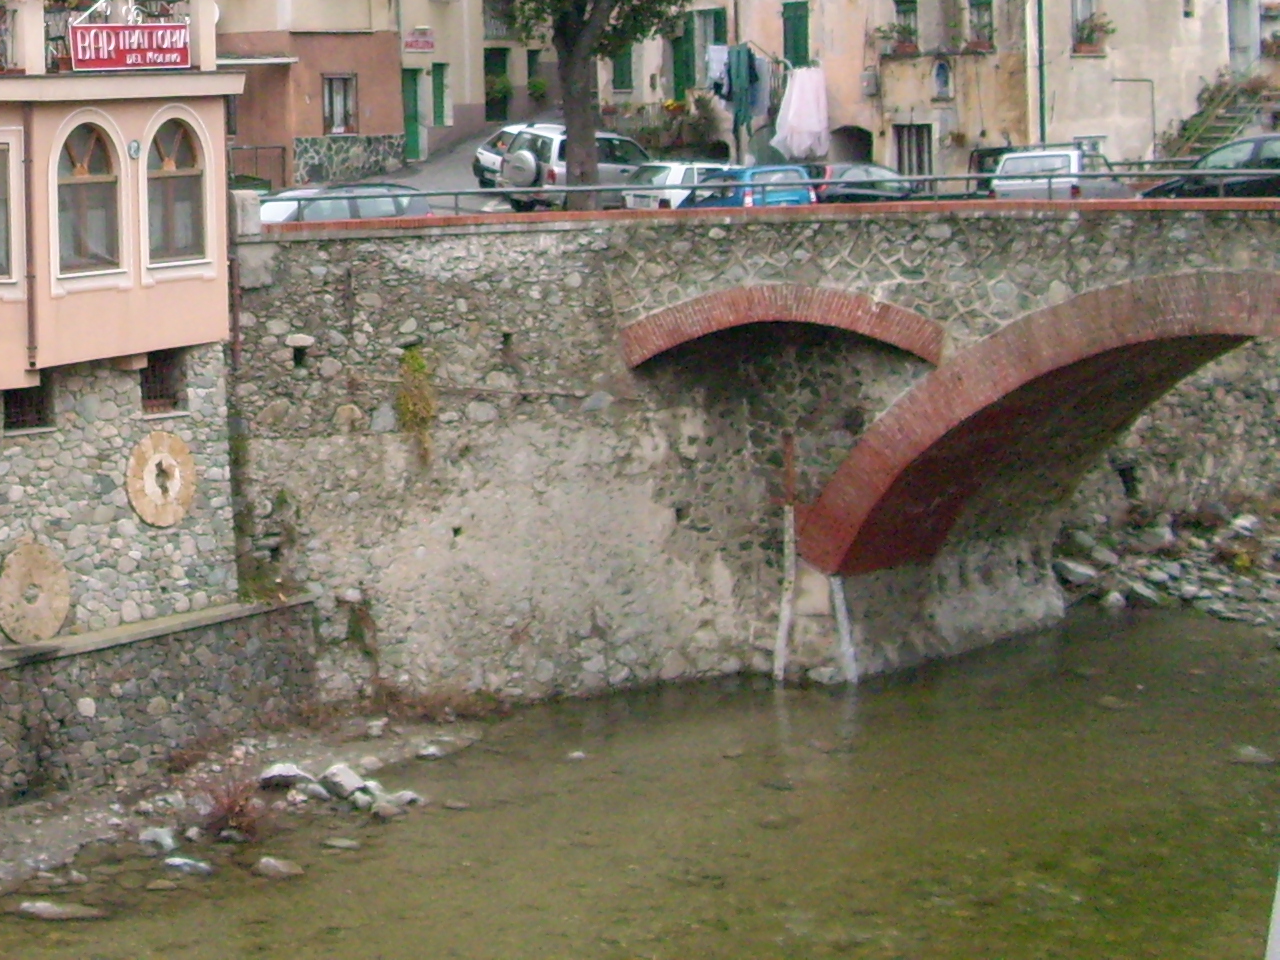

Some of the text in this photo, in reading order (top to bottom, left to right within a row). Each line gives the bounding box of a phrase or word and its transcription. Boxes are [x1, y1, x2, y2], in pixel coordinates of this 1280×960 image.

[77, 28, 189, 60] BAR TRATTORIA
[126, 52, 143, 64] DEL
